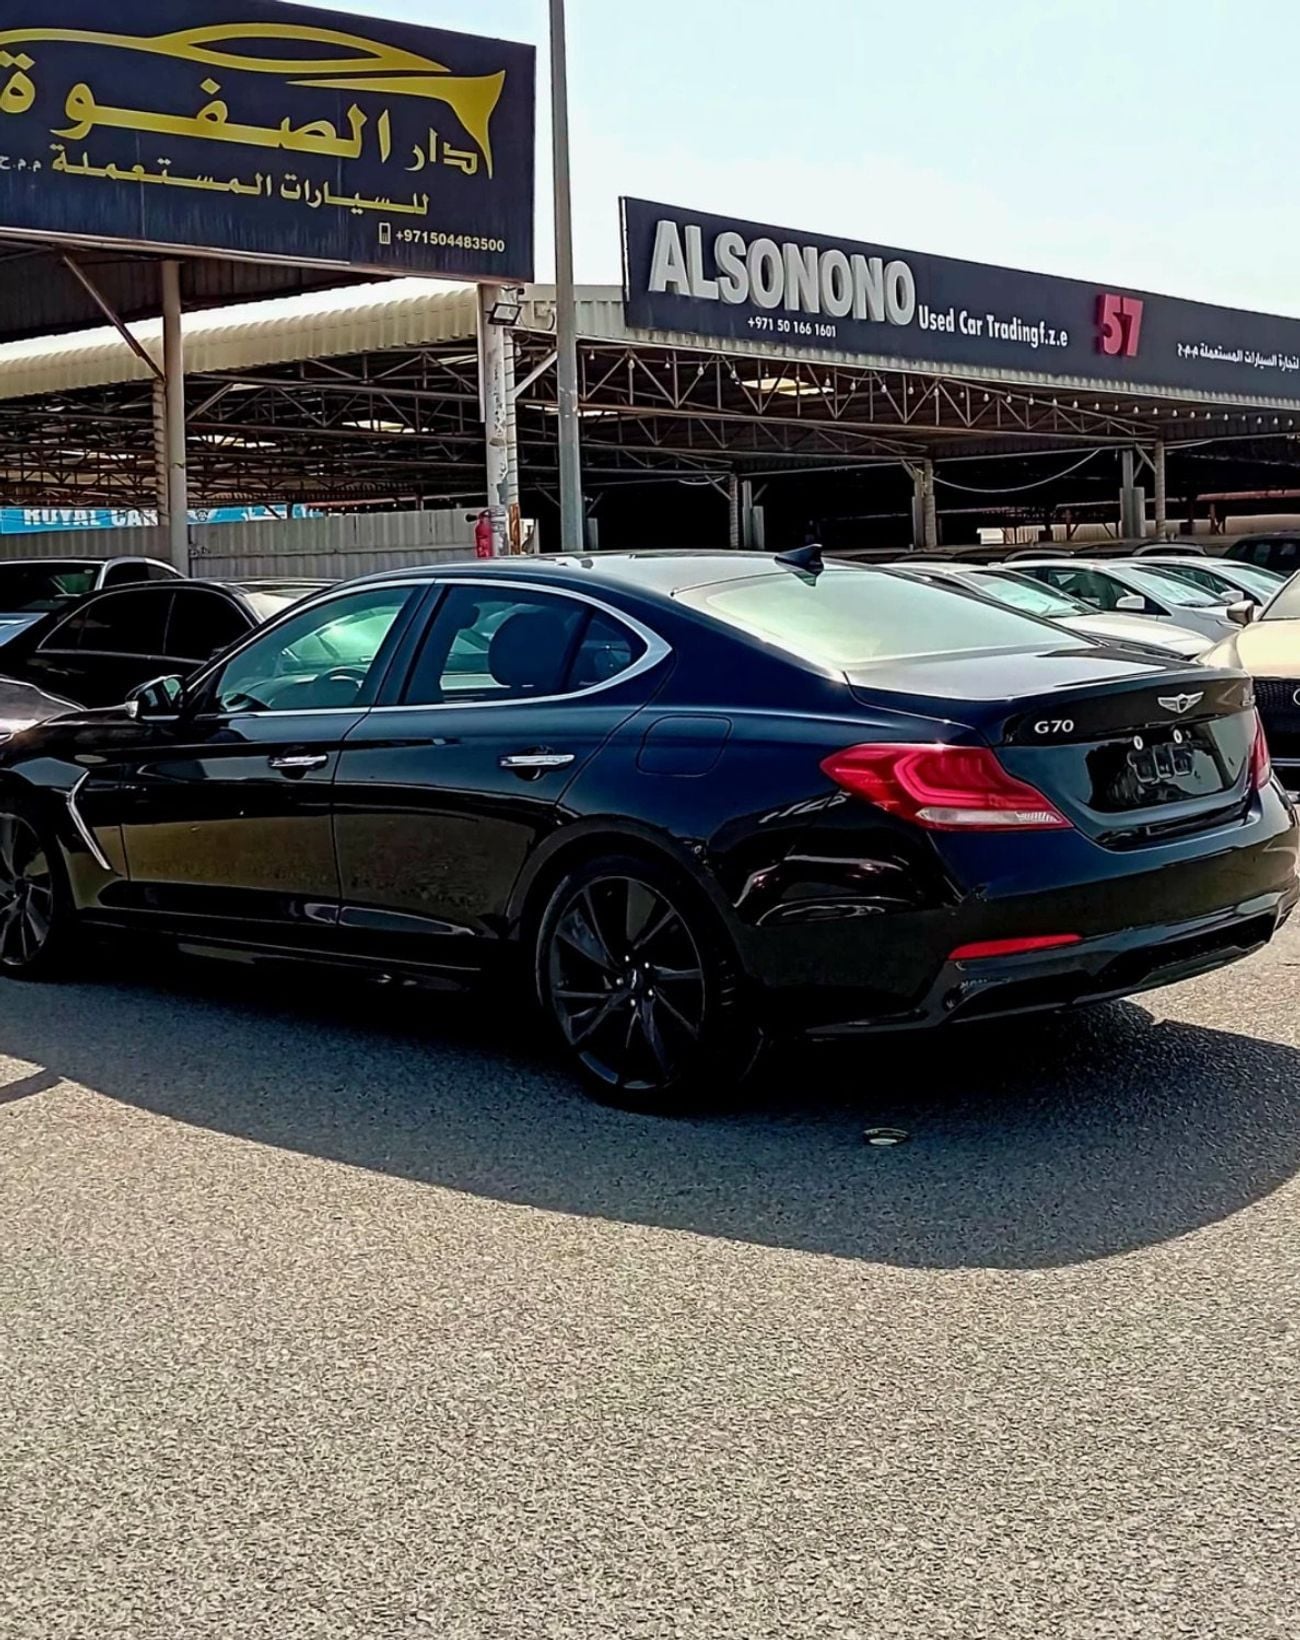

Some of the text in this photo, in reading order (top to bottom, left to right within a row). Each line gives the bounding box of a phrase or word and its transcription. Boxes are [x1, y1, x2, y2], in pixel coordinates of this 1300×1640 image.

[0, 50, 479, 175] دار الصفوة
[50, 143, 273, 198] المستعملة
[279, 172, 430, 216] للسيارات
[396, 229, 505, 253] +971504483500
[648, 219, 916, 327] ALSONONO
[747, 316, 837, 338] +971 50 166 1601
[918, 304, 955, 333] Used
[959, 310, 983, 336] Car
[1099, 293, 1144, 358] 57
[1034, 719, 1075, 734] G70
